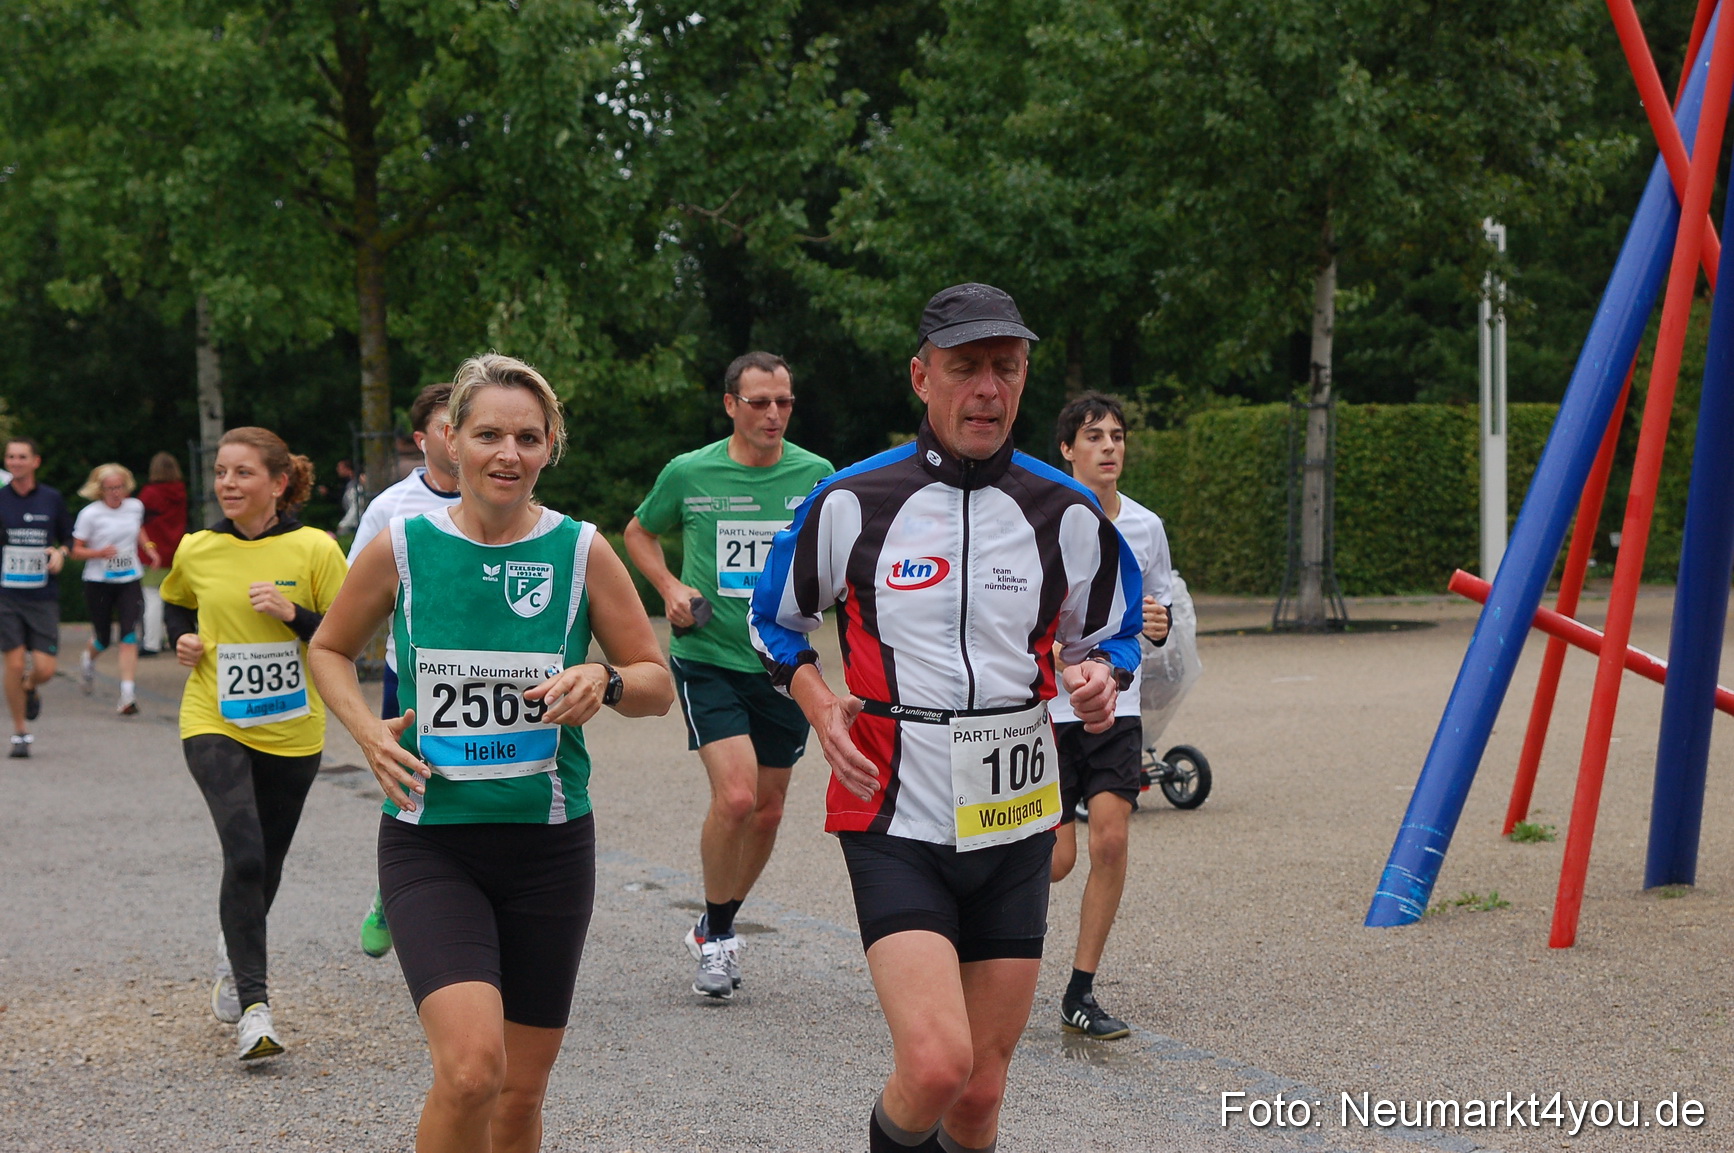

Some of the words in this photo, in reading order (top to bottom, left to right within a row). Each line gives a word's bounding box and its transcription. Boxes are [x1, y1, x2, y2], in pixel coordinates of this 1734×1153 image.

[509, 565, 550, 573] EZELSDORF
[891, 559, 933, 578] tkn
[992, 567, 1011, 575] team
[997, 575, 1028, 584] klinikum
[517, 579, 529, 596] F
[530, 592, 541, 608] C
[985, 583, 1019, 593] nürnberg
[218, 652, 248, 661] PARTL
[250, 650, 294, 660] Neumarkt
[227, 660, 300, 695] 2933
[419, 662, 466, 677] PARTL
[470, 665, 539, 678] Neumarkt
[245, 699, 286, 716] Angela
[432, 682, 549, 728] 2569
[905, 709, 943, 718] unlimited
[423, 725, 429, 733] B
[953, 729, 1000, 743] PARTL
[1003, 716, 1042, 739] Neumarkt
[465, 741, 517, 761] Heike
[982, 736, 1045, 795] 106
[958, 796, 964, 805] C
[979, 799, 1043, 828] Wolfgang
